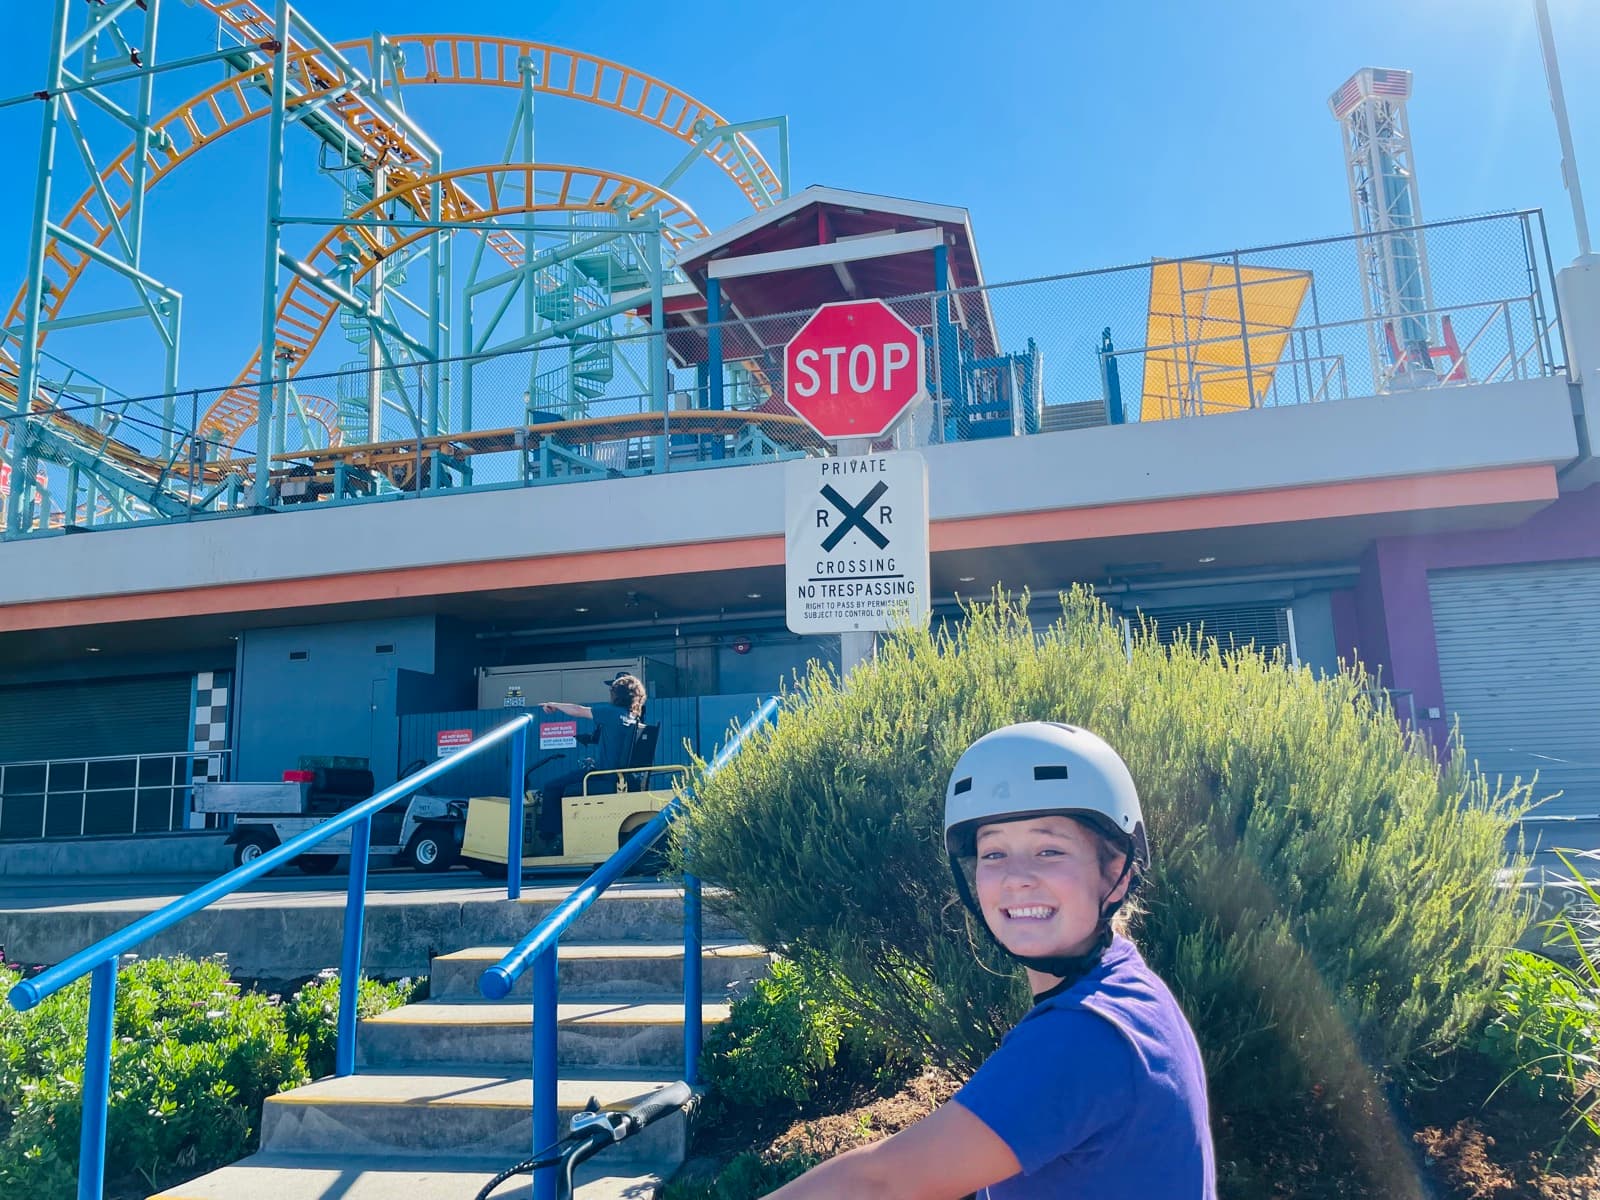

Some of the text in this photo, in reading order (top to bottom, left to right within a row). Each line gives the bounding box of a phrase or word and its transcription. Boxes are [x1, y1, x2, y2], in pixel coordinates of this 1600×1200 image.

[794, 342, 910, 397] STOP
[822, 459, 886, 475] PRIVATE
[816, 509, 829, 528] R
[880, 506, 893, 524] R
[816, 558, 896, 574] CROSSING
[798, 581, 915, 599] NO TRESPASSING
[805, 602, 824, 610] RIGHT
[837, 601, 855, 609] PASS
[857, 600, 865, 608] BY
[804, 610, 832, 619] SUBJECT
[835, 610, 843, 618] TO
[845, 609, 874, 617] CONTROL
